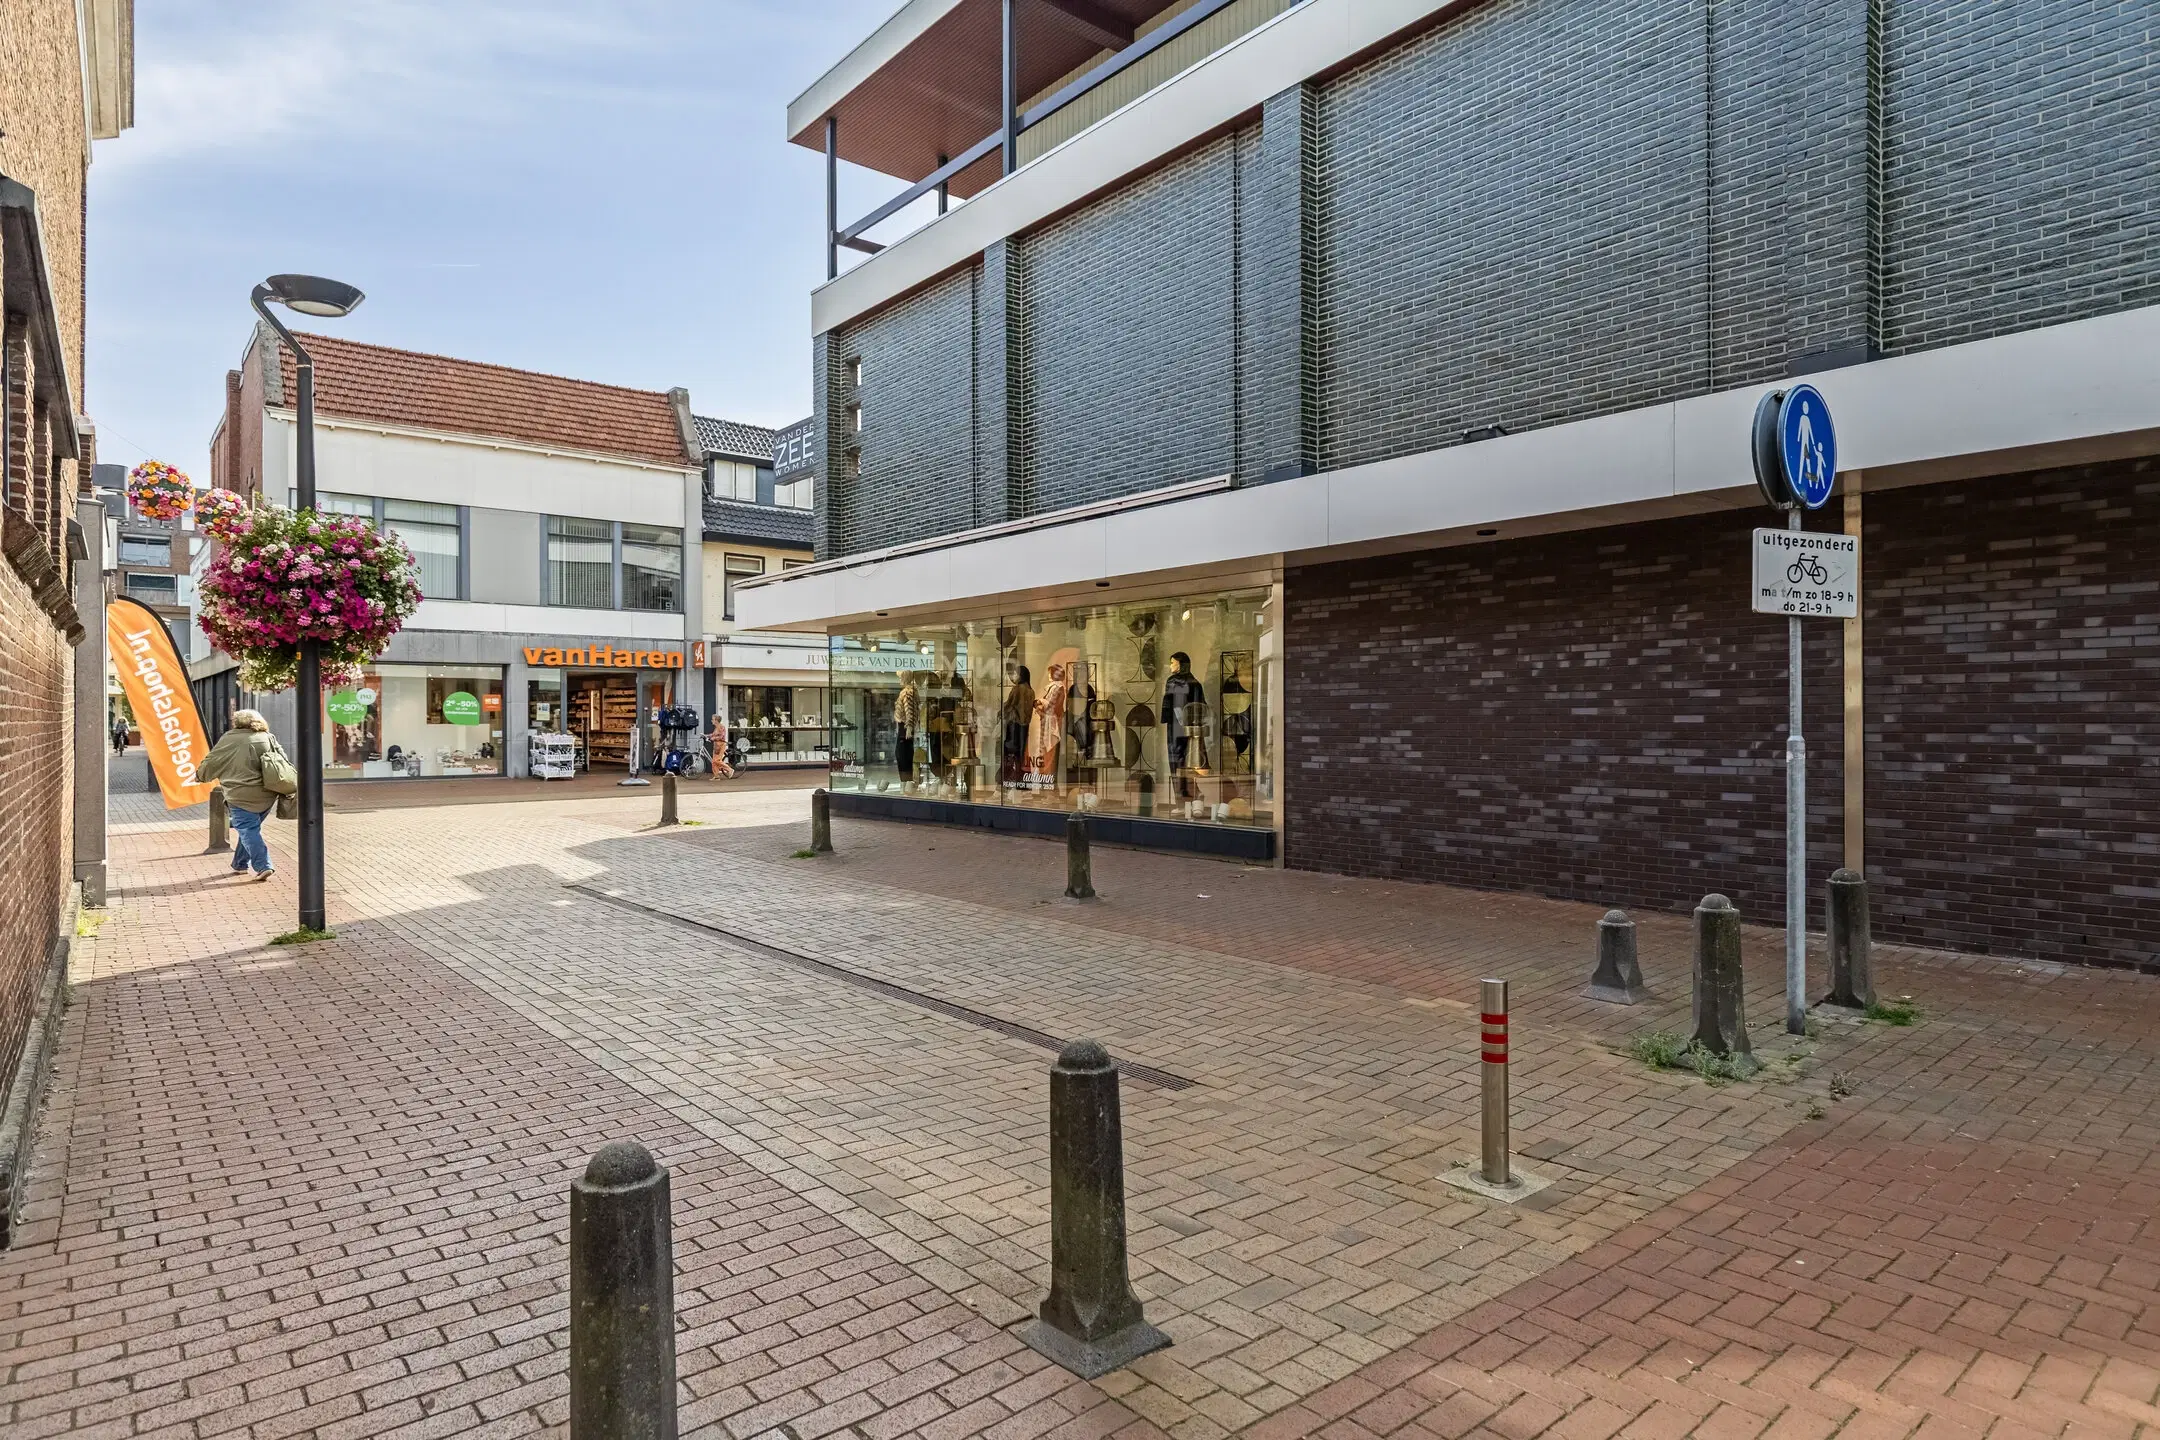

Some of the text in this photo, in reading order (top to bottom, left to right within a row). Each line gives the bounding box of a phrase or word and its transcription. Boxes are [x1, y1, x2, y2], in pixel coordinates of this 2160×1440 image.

[775, 432, 814, 468] ZEE
[1763, 533, 1854, 552] uitgezonderd
[1805, 591, 1818, 600] zo
[1821, 590, 1844, 601] 18-9
[1847, 592, 1854, 602] h
[1783, 601, 1832, 614] do 21-9 h
[523, 644, 683, 668] vanHaren
[868, 656, 891, 667] VAN
[894, 657, 917, 669] DER
[1022, 767, 1055, 783] autumn
